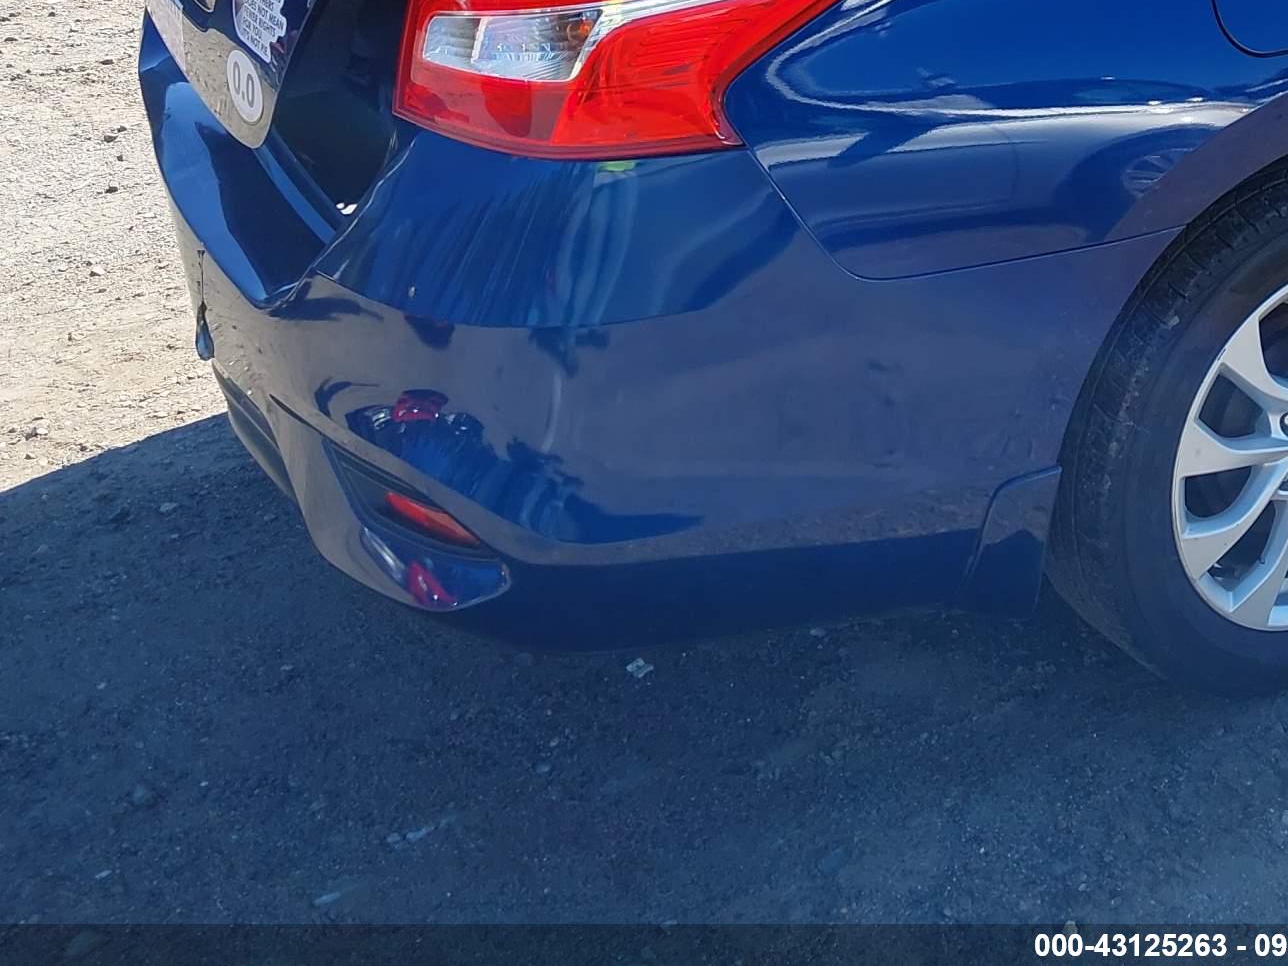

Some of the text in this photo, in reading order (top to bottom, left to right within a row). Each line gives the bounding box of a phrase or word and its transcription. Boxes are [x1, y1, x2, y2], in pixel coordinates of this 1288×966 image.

[257, 4, 269, 18] NOT
[269, 13, 285, 31] MEAN
[258, 16, 276, 37] RIGHTS
[249, 34, 261, 51] NOT
[233, 60, 255, 108] 0.0
